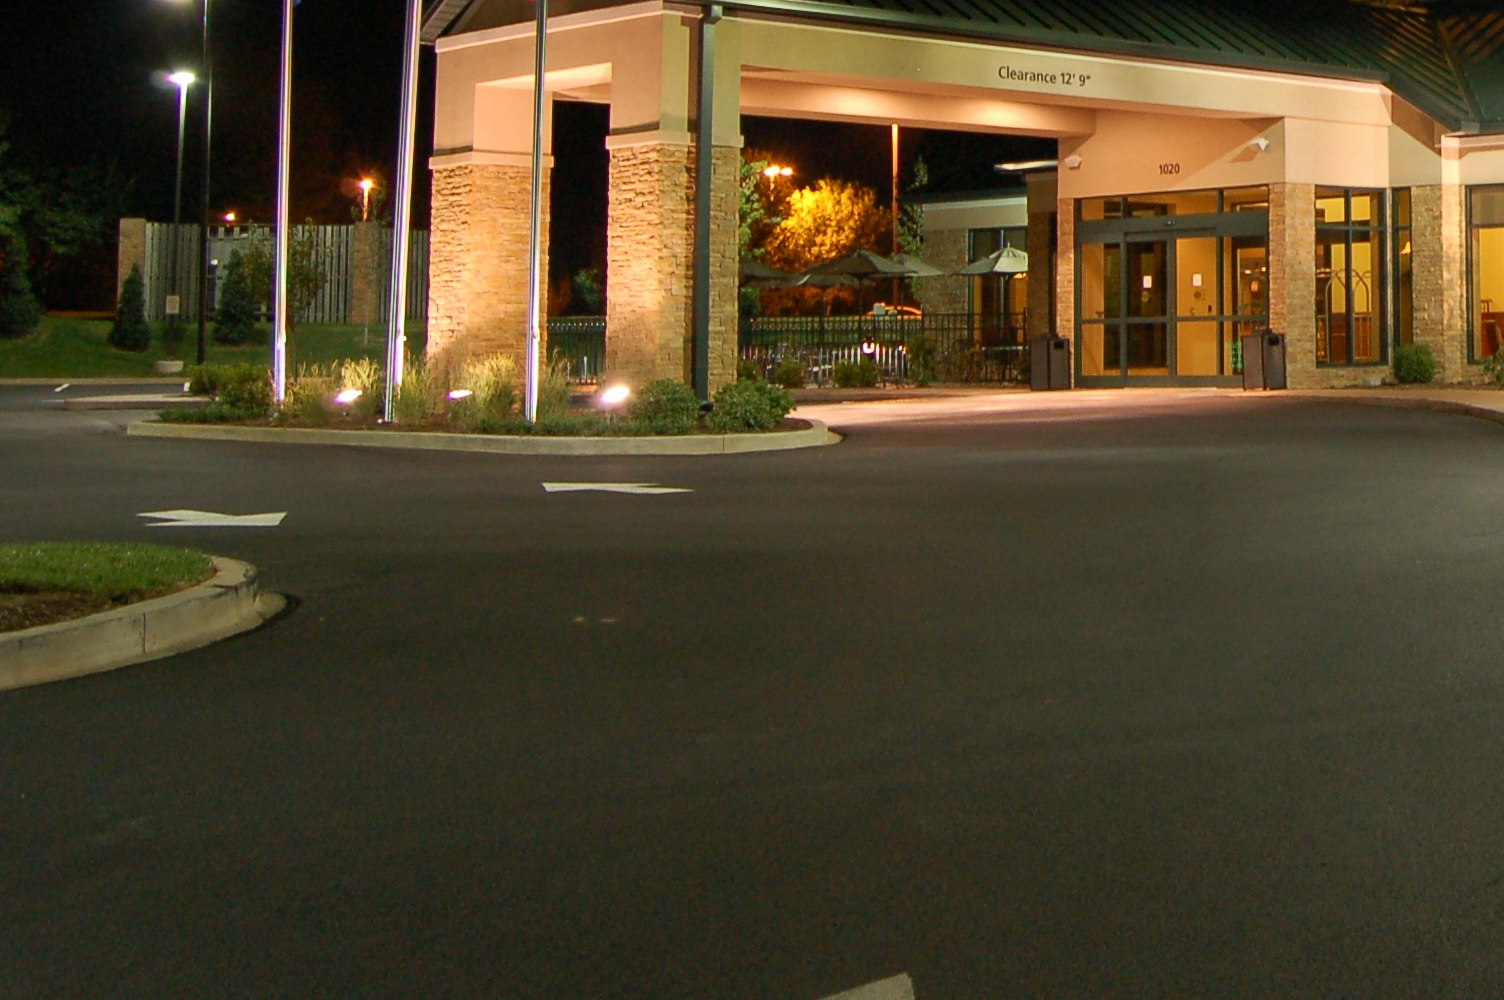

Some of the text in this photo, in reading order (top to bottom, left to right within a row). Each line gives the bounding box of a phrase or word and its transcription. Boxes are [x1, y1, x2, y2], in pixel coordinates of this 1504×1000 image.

[997, 65, 1057, 85] Clearance
[1060, 72, 1076, 86] 12'
[1157, 162, 1181, 176] 1020
